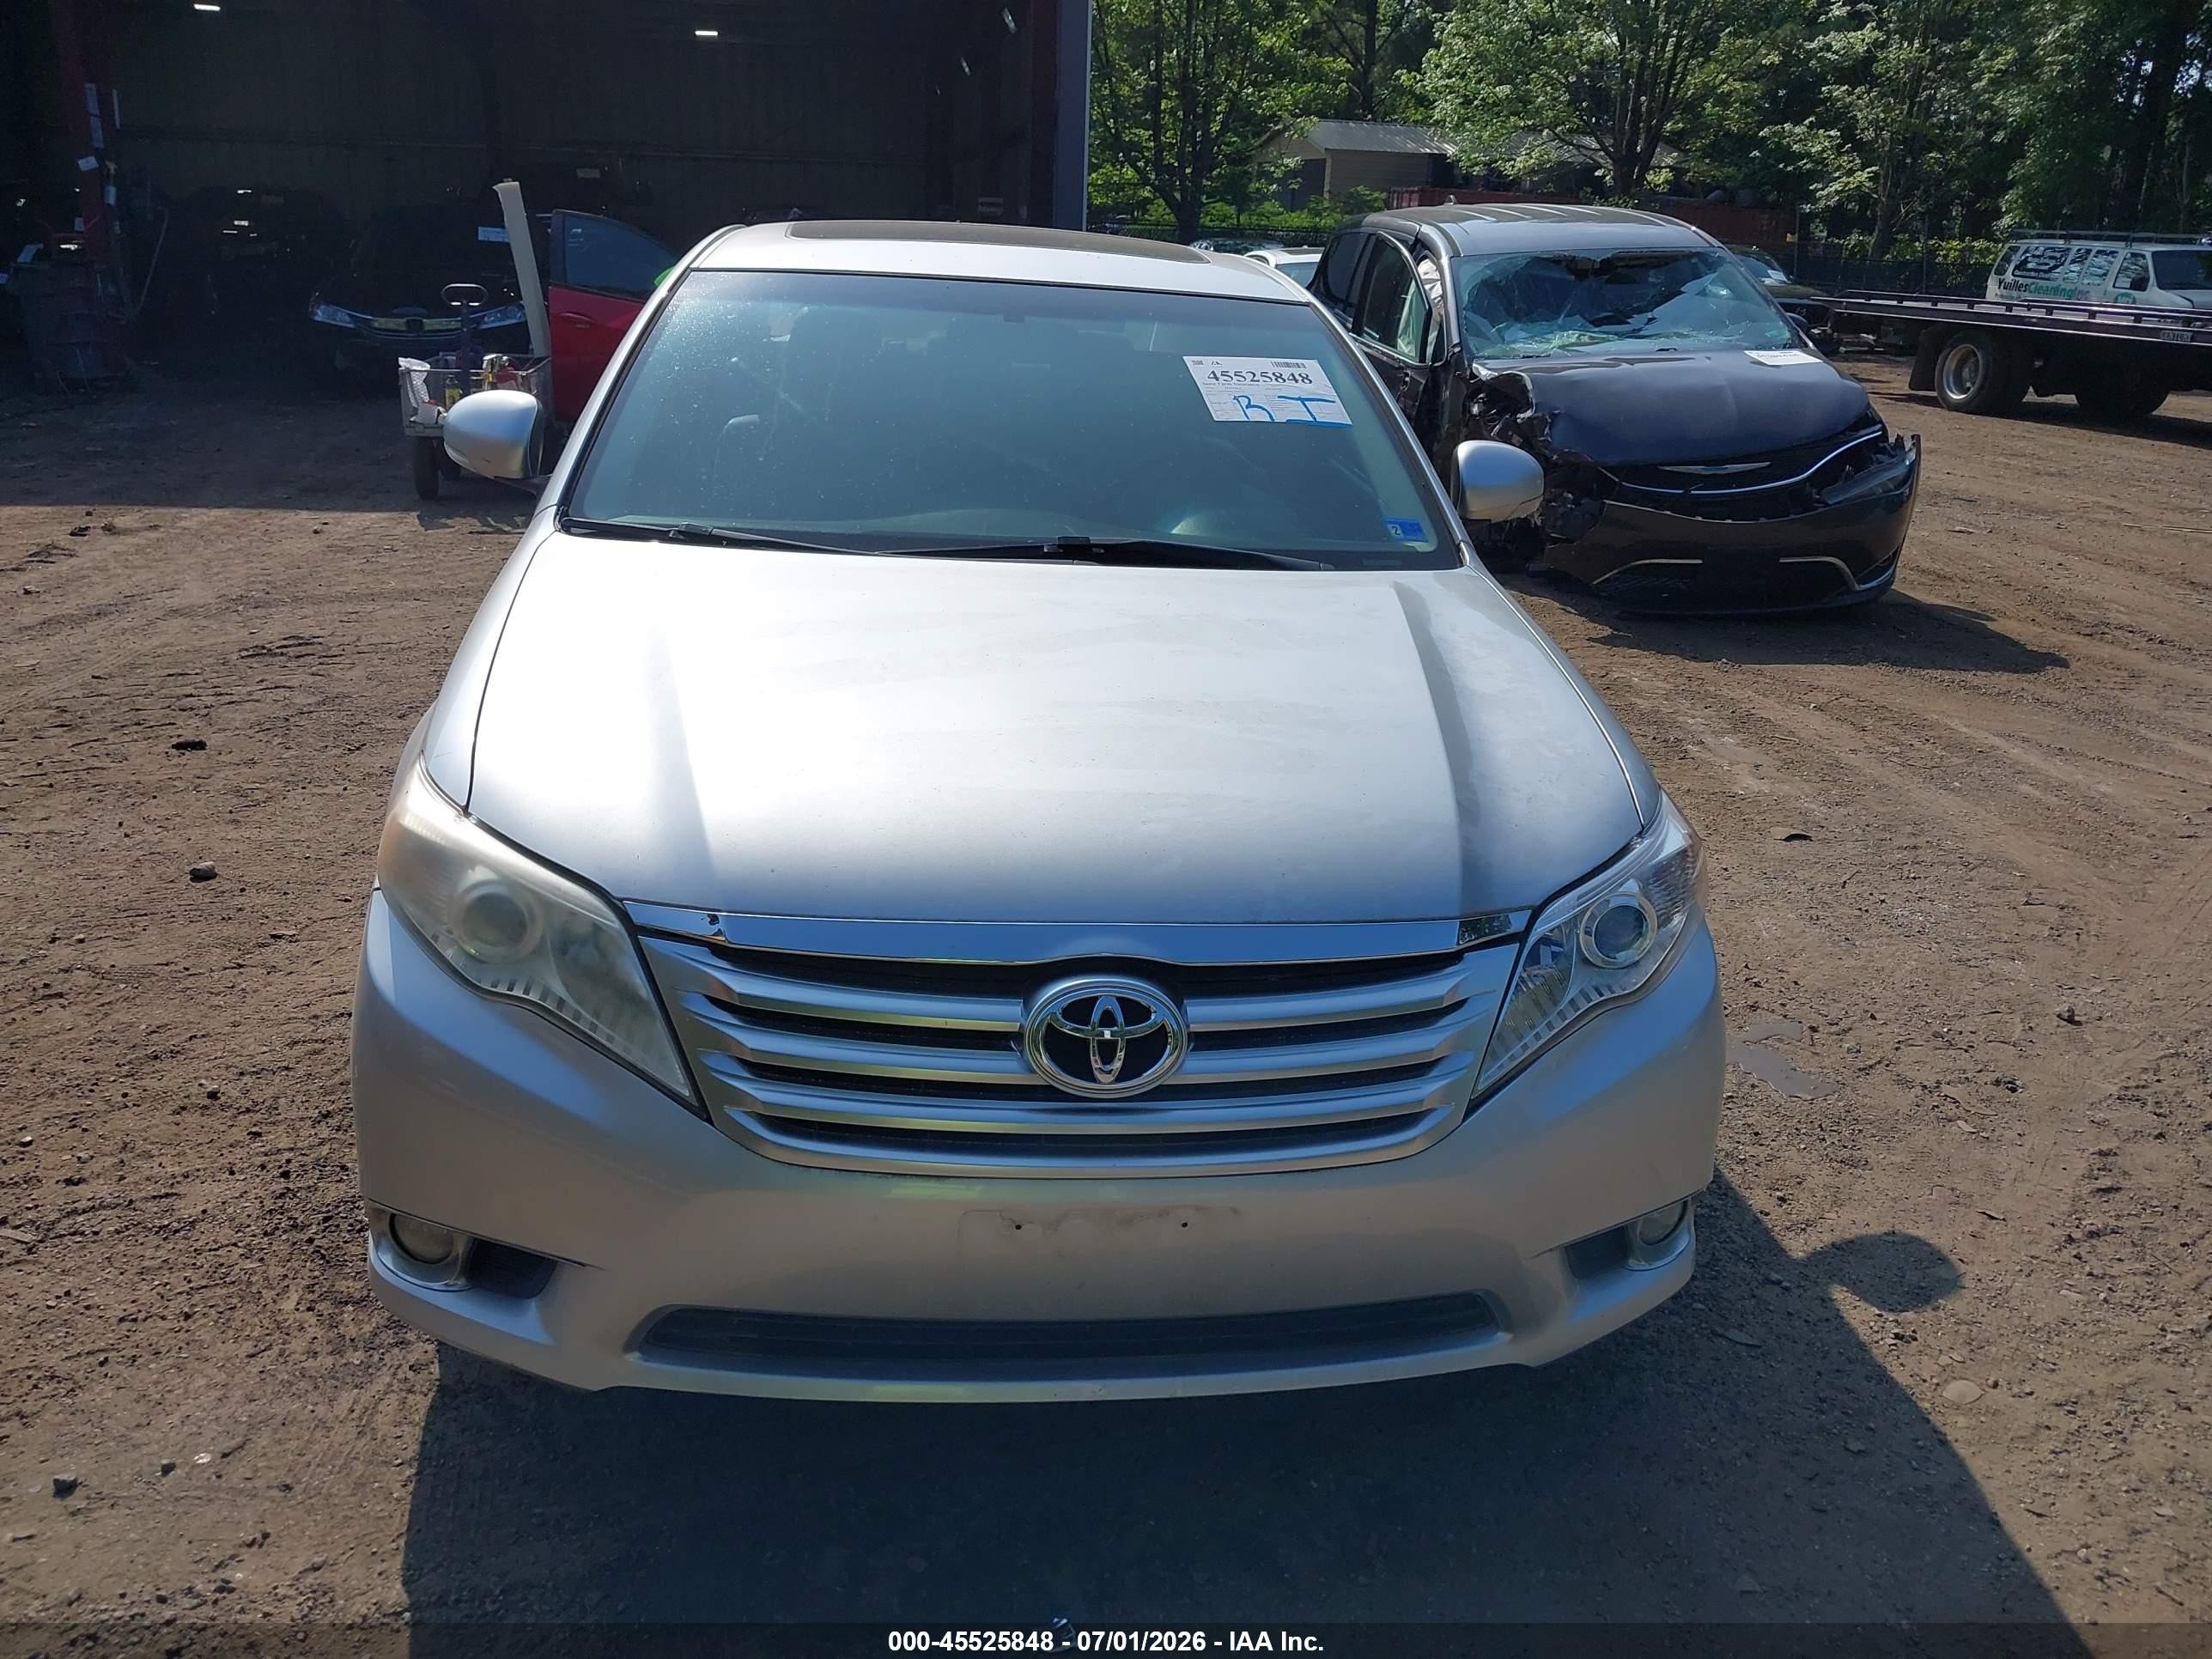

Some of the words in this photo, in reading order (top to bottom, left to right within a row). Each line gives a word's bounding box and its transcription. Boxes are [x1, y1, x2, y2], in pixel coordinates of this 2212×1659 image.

[2160, 330, 2193, 342] CENTURY
[1207, 370, 1313, 385] 45525848
[1391, 526, 1401, 536] 2
